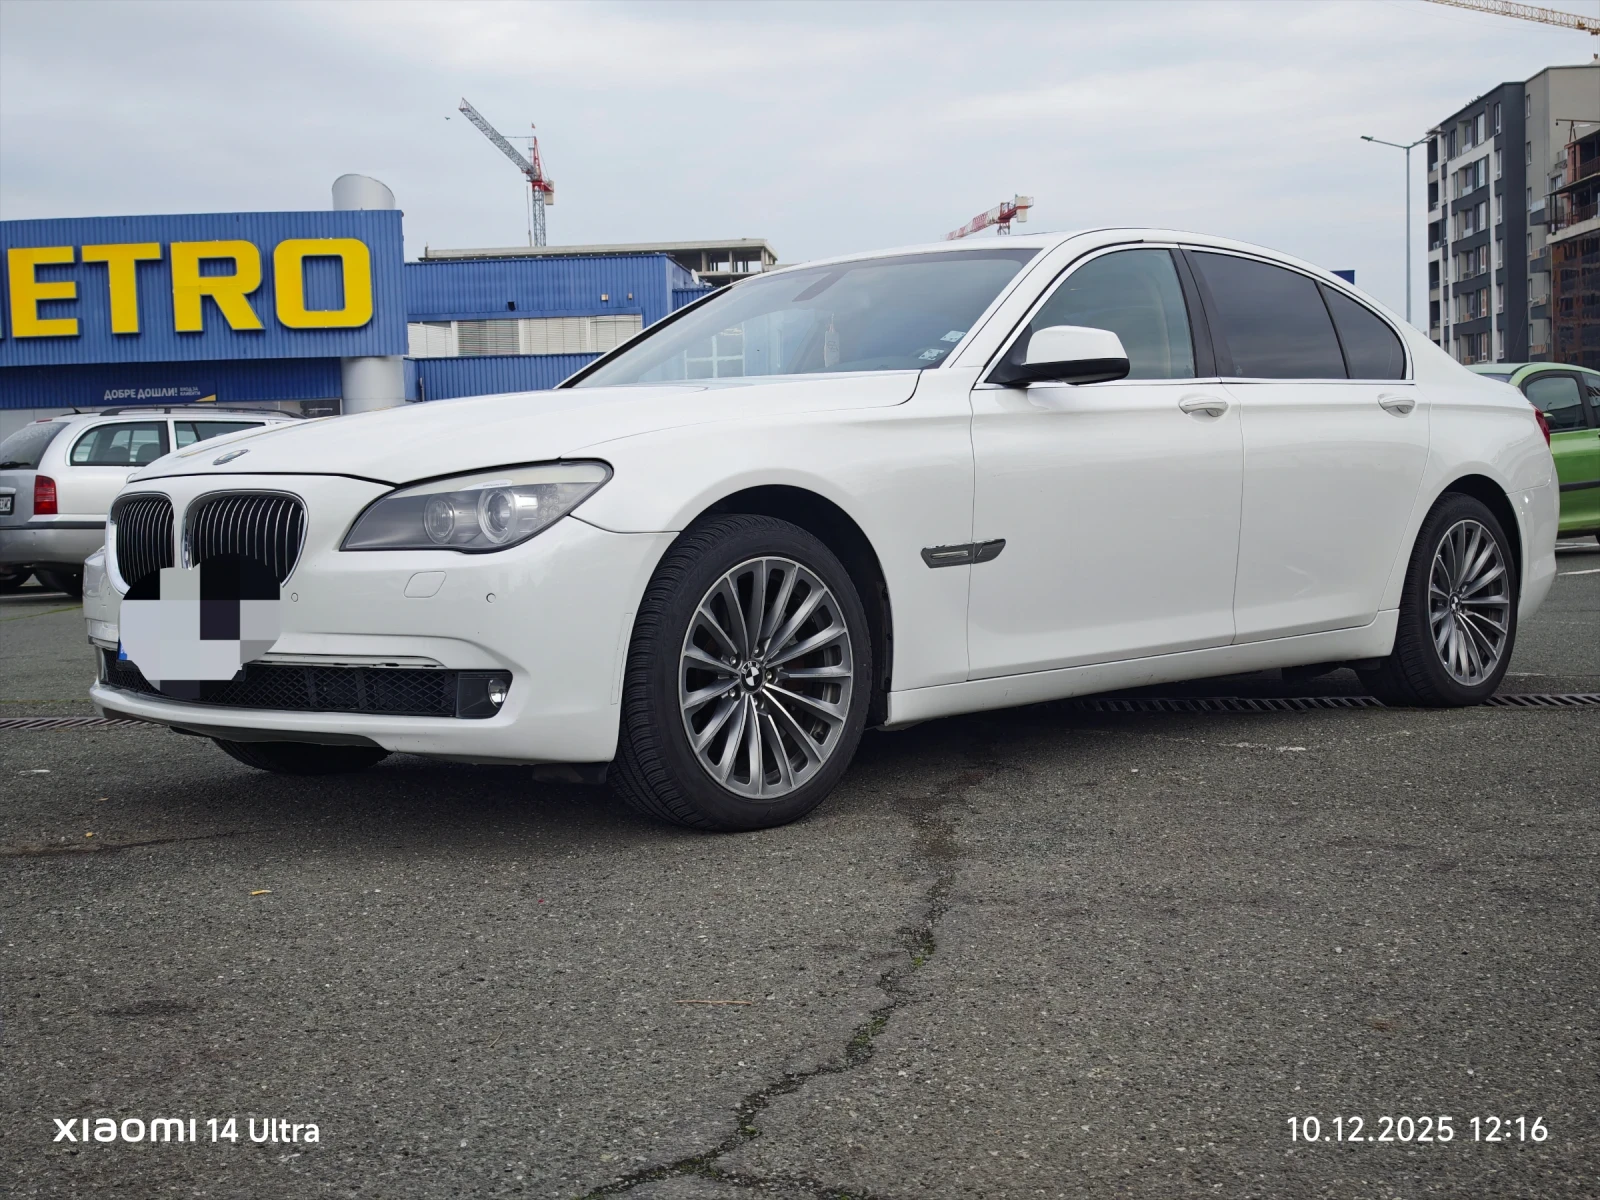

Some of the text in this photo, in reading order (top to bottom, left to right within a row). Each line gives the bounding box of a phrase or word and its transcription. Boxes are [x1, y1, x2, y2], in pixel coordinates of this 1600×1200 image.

[0, 238, 374, 339] ETRO
[104, 387, 178, 401] ДОБРЕ ДОШЛИ!
